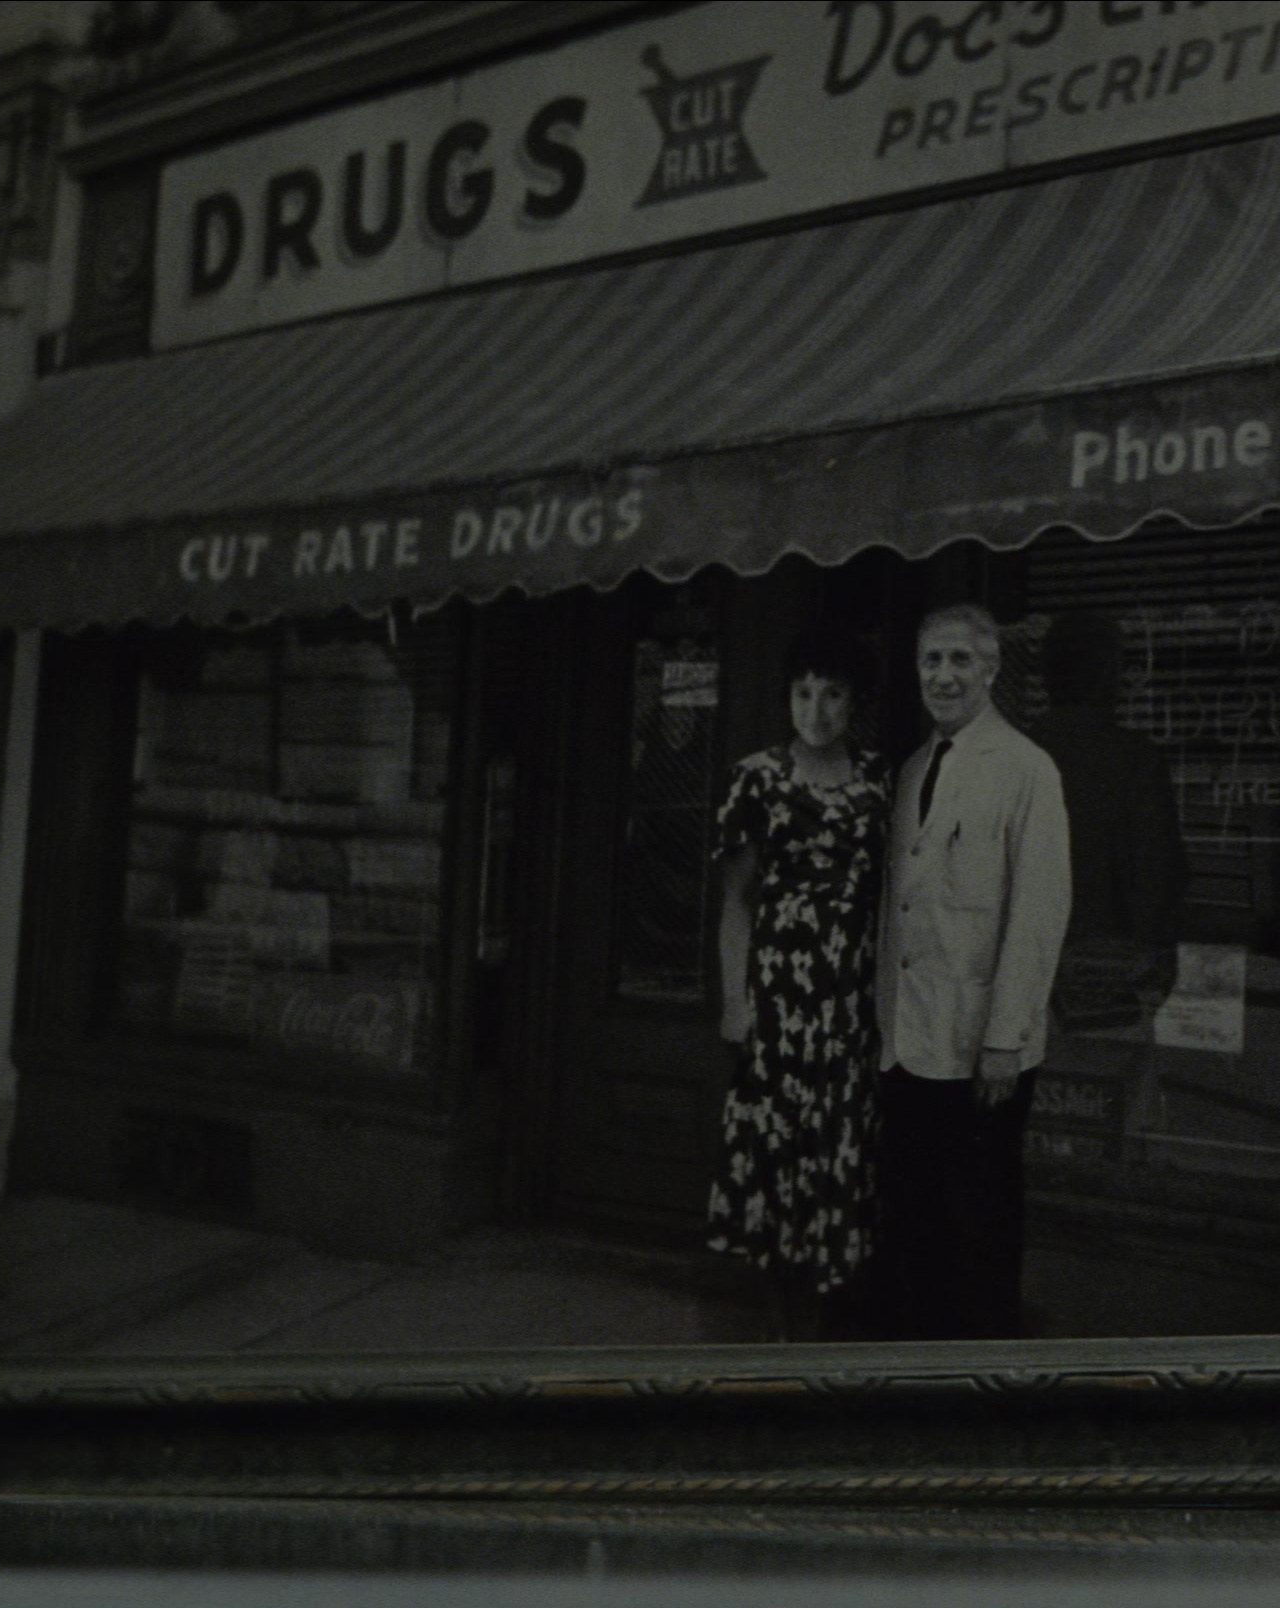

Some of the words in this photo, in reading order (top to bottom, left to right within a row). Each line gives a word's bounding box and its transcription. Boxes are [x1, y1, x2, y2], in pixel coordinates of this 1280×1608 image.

[670, 79, 736, 133] CUT
[188, 97, 588, 297] DRUGS
[662, 134, 738, 190] RATE
[1070, 418, 1273, 488] Phone
[179, 534, 270, 582] CUT
[292, 518, 420, 578] RATE
[450, 488, 644, 560] DRUGS
